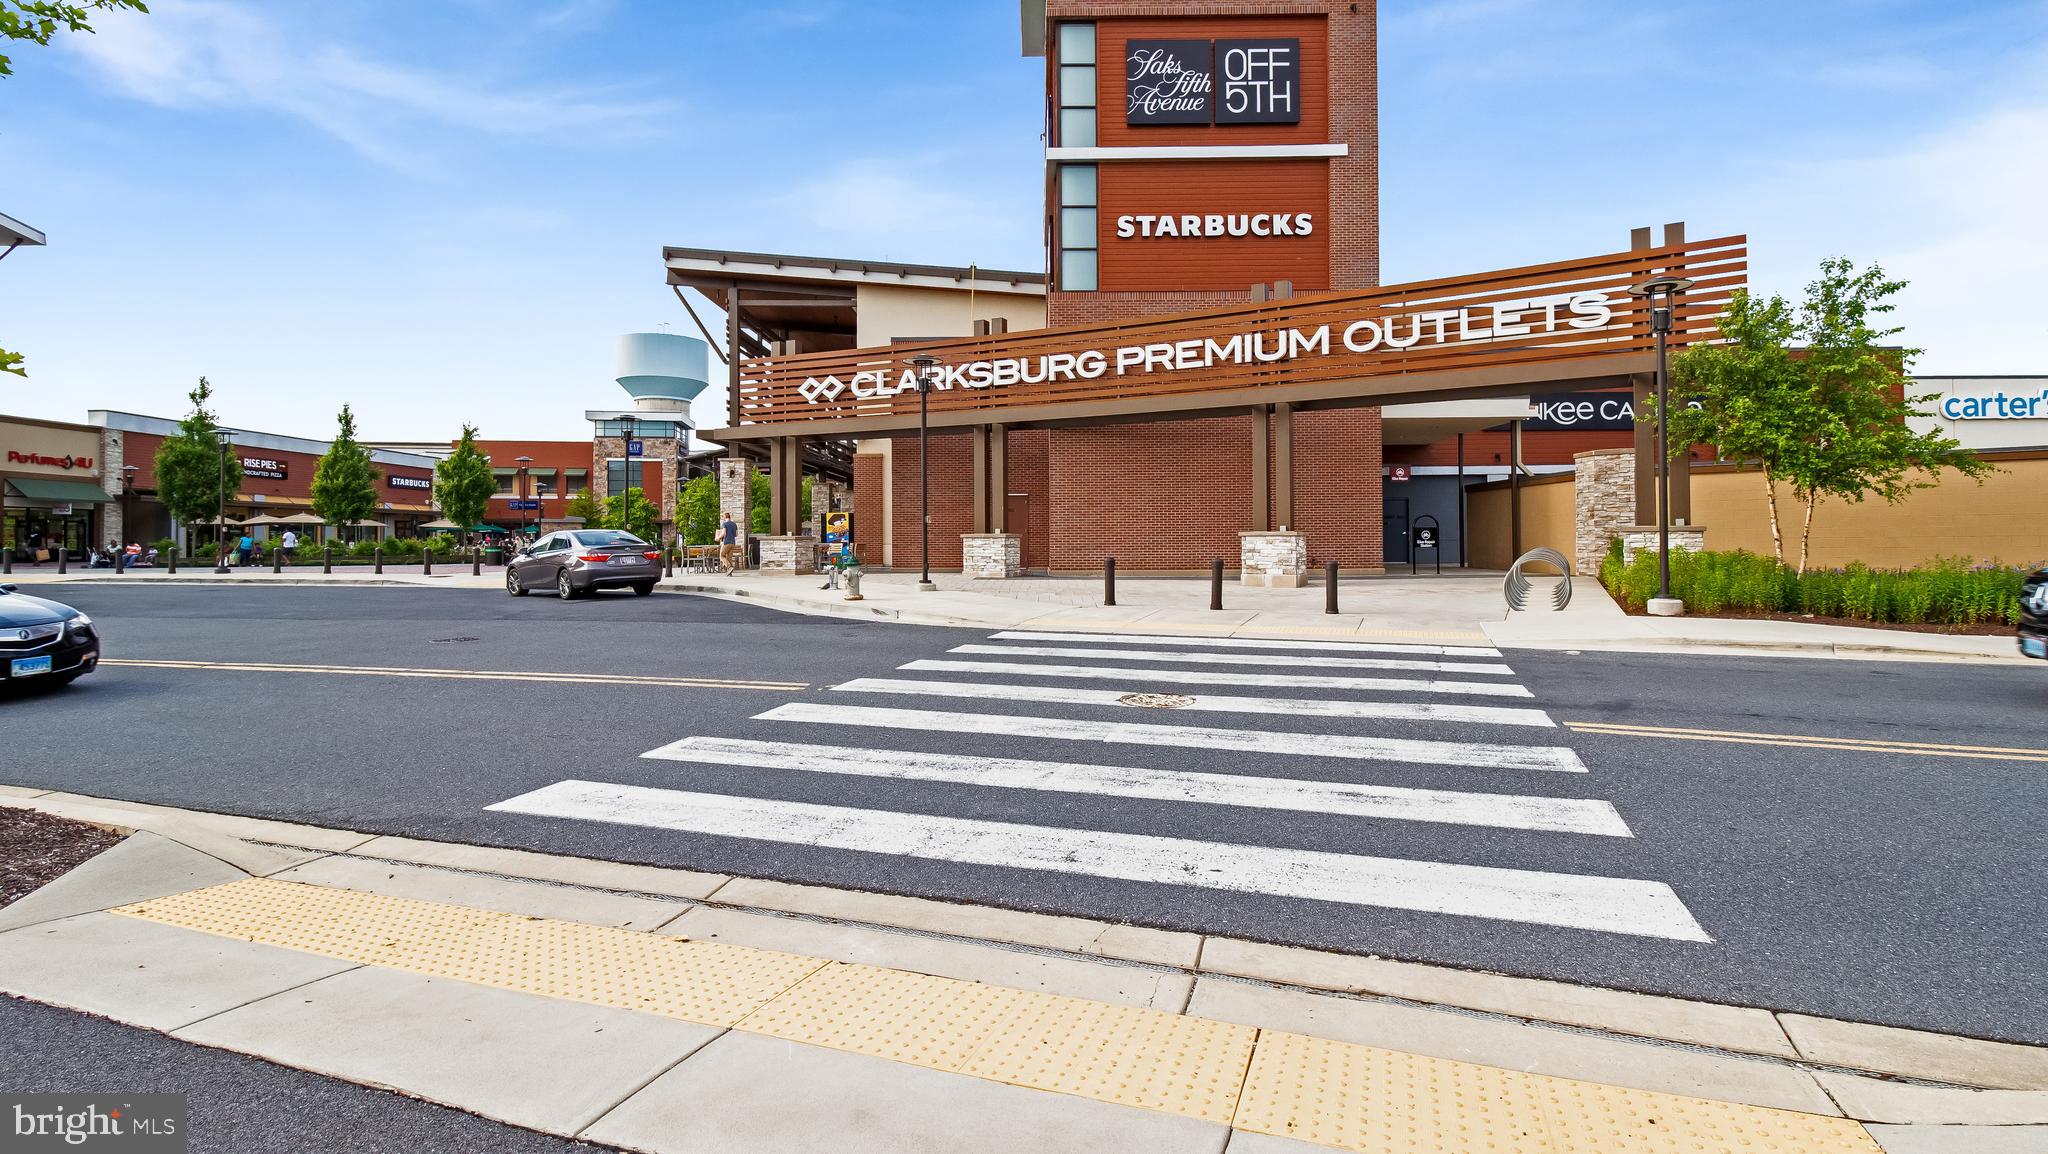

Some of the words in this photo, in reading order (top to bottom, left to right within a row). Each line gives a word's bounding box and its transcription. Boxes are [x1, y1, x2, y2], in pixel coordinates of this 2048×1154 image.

[1127, 49, 1181, 80] Saks
[1225, 48, 1290, 80] OFF
[1127, 85, 1204, 115] Avenue
[1225, 81, 1290, 113] 5TH
[1116, 213, 1313, 238] STARBUCKS
[851, 351, 1107, 397] CLARKSBURG
[1116, 325, 1330, 375] PREMIUM
[1343, 293, 1611, 353] OUTLETS
[1945, 390, 2048, 417] carter'
[8, 451, 67, 468] Perfumes
[244, 458, 260, 468] RISE
[261, 460, 277, 470] PIES
[392, 478, 430, 488] STARBUCKS
